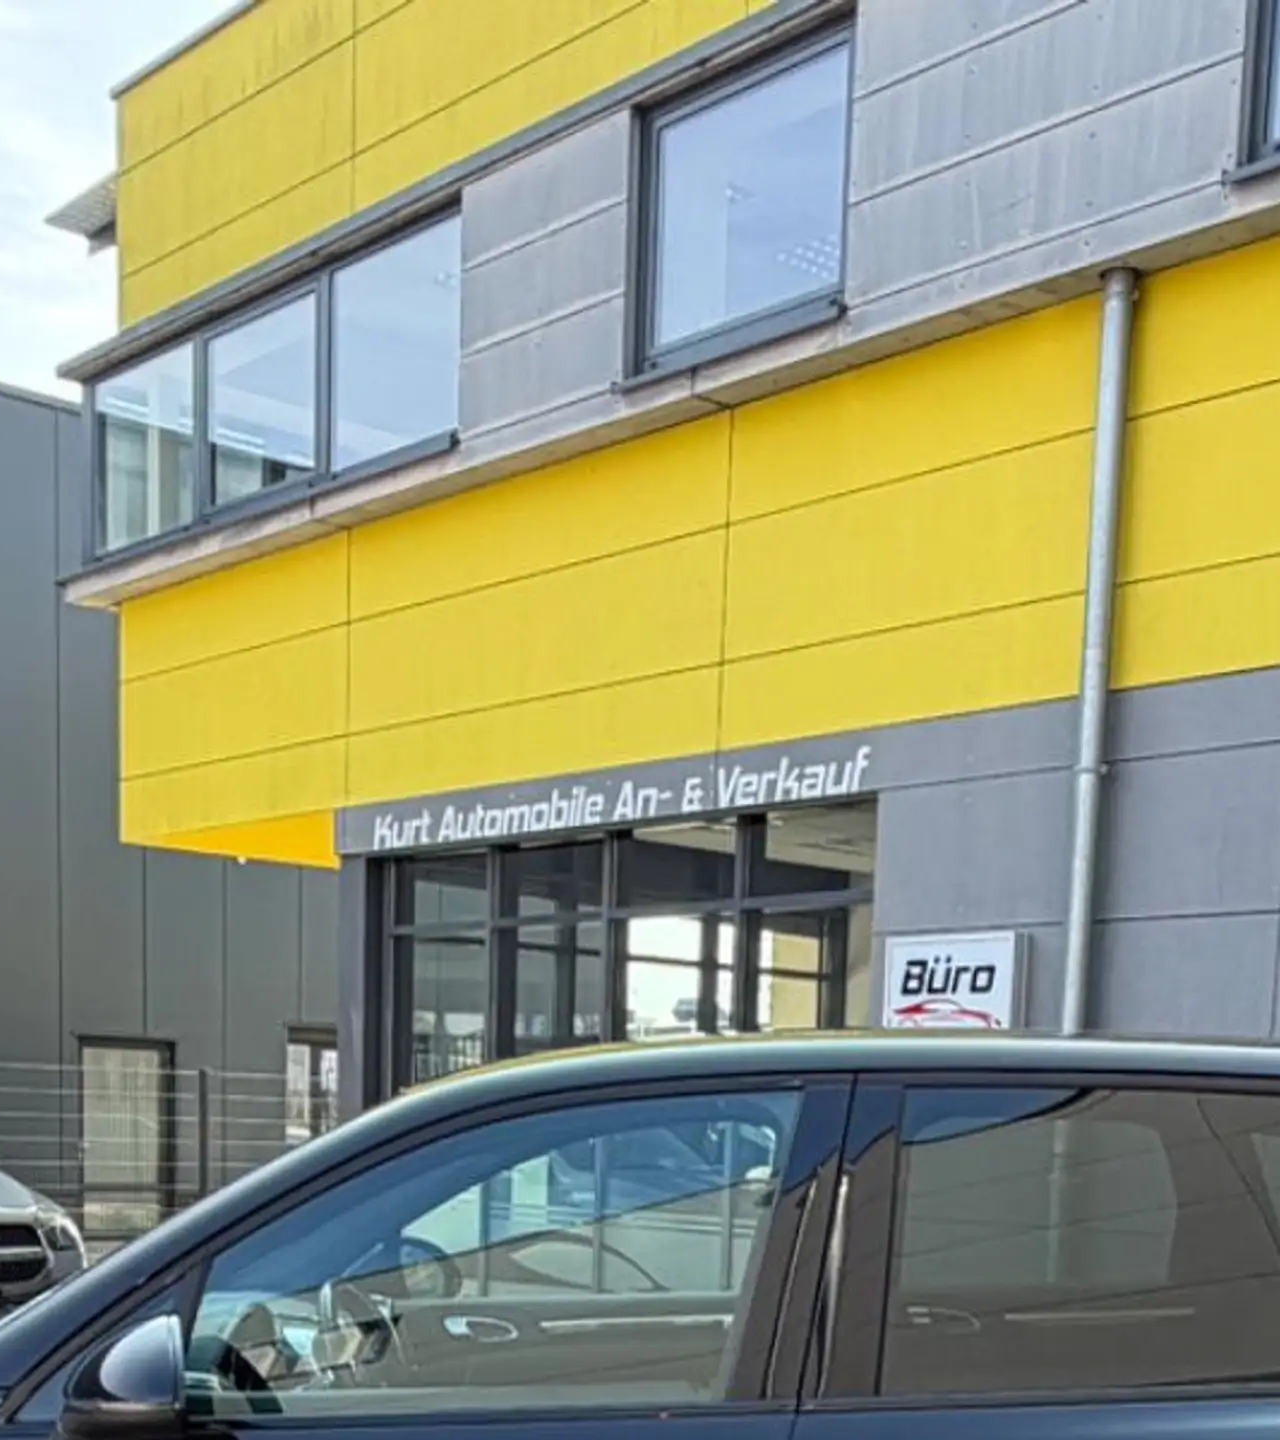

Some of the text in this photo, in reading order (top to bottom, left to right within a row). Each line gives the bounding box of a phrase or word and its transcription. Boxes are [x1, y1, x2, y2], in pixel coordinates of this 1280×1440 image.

[373, 746, 871, 850] Kurt Automobile An- & Verkauf
[900, 954, 997, 997] Büro
